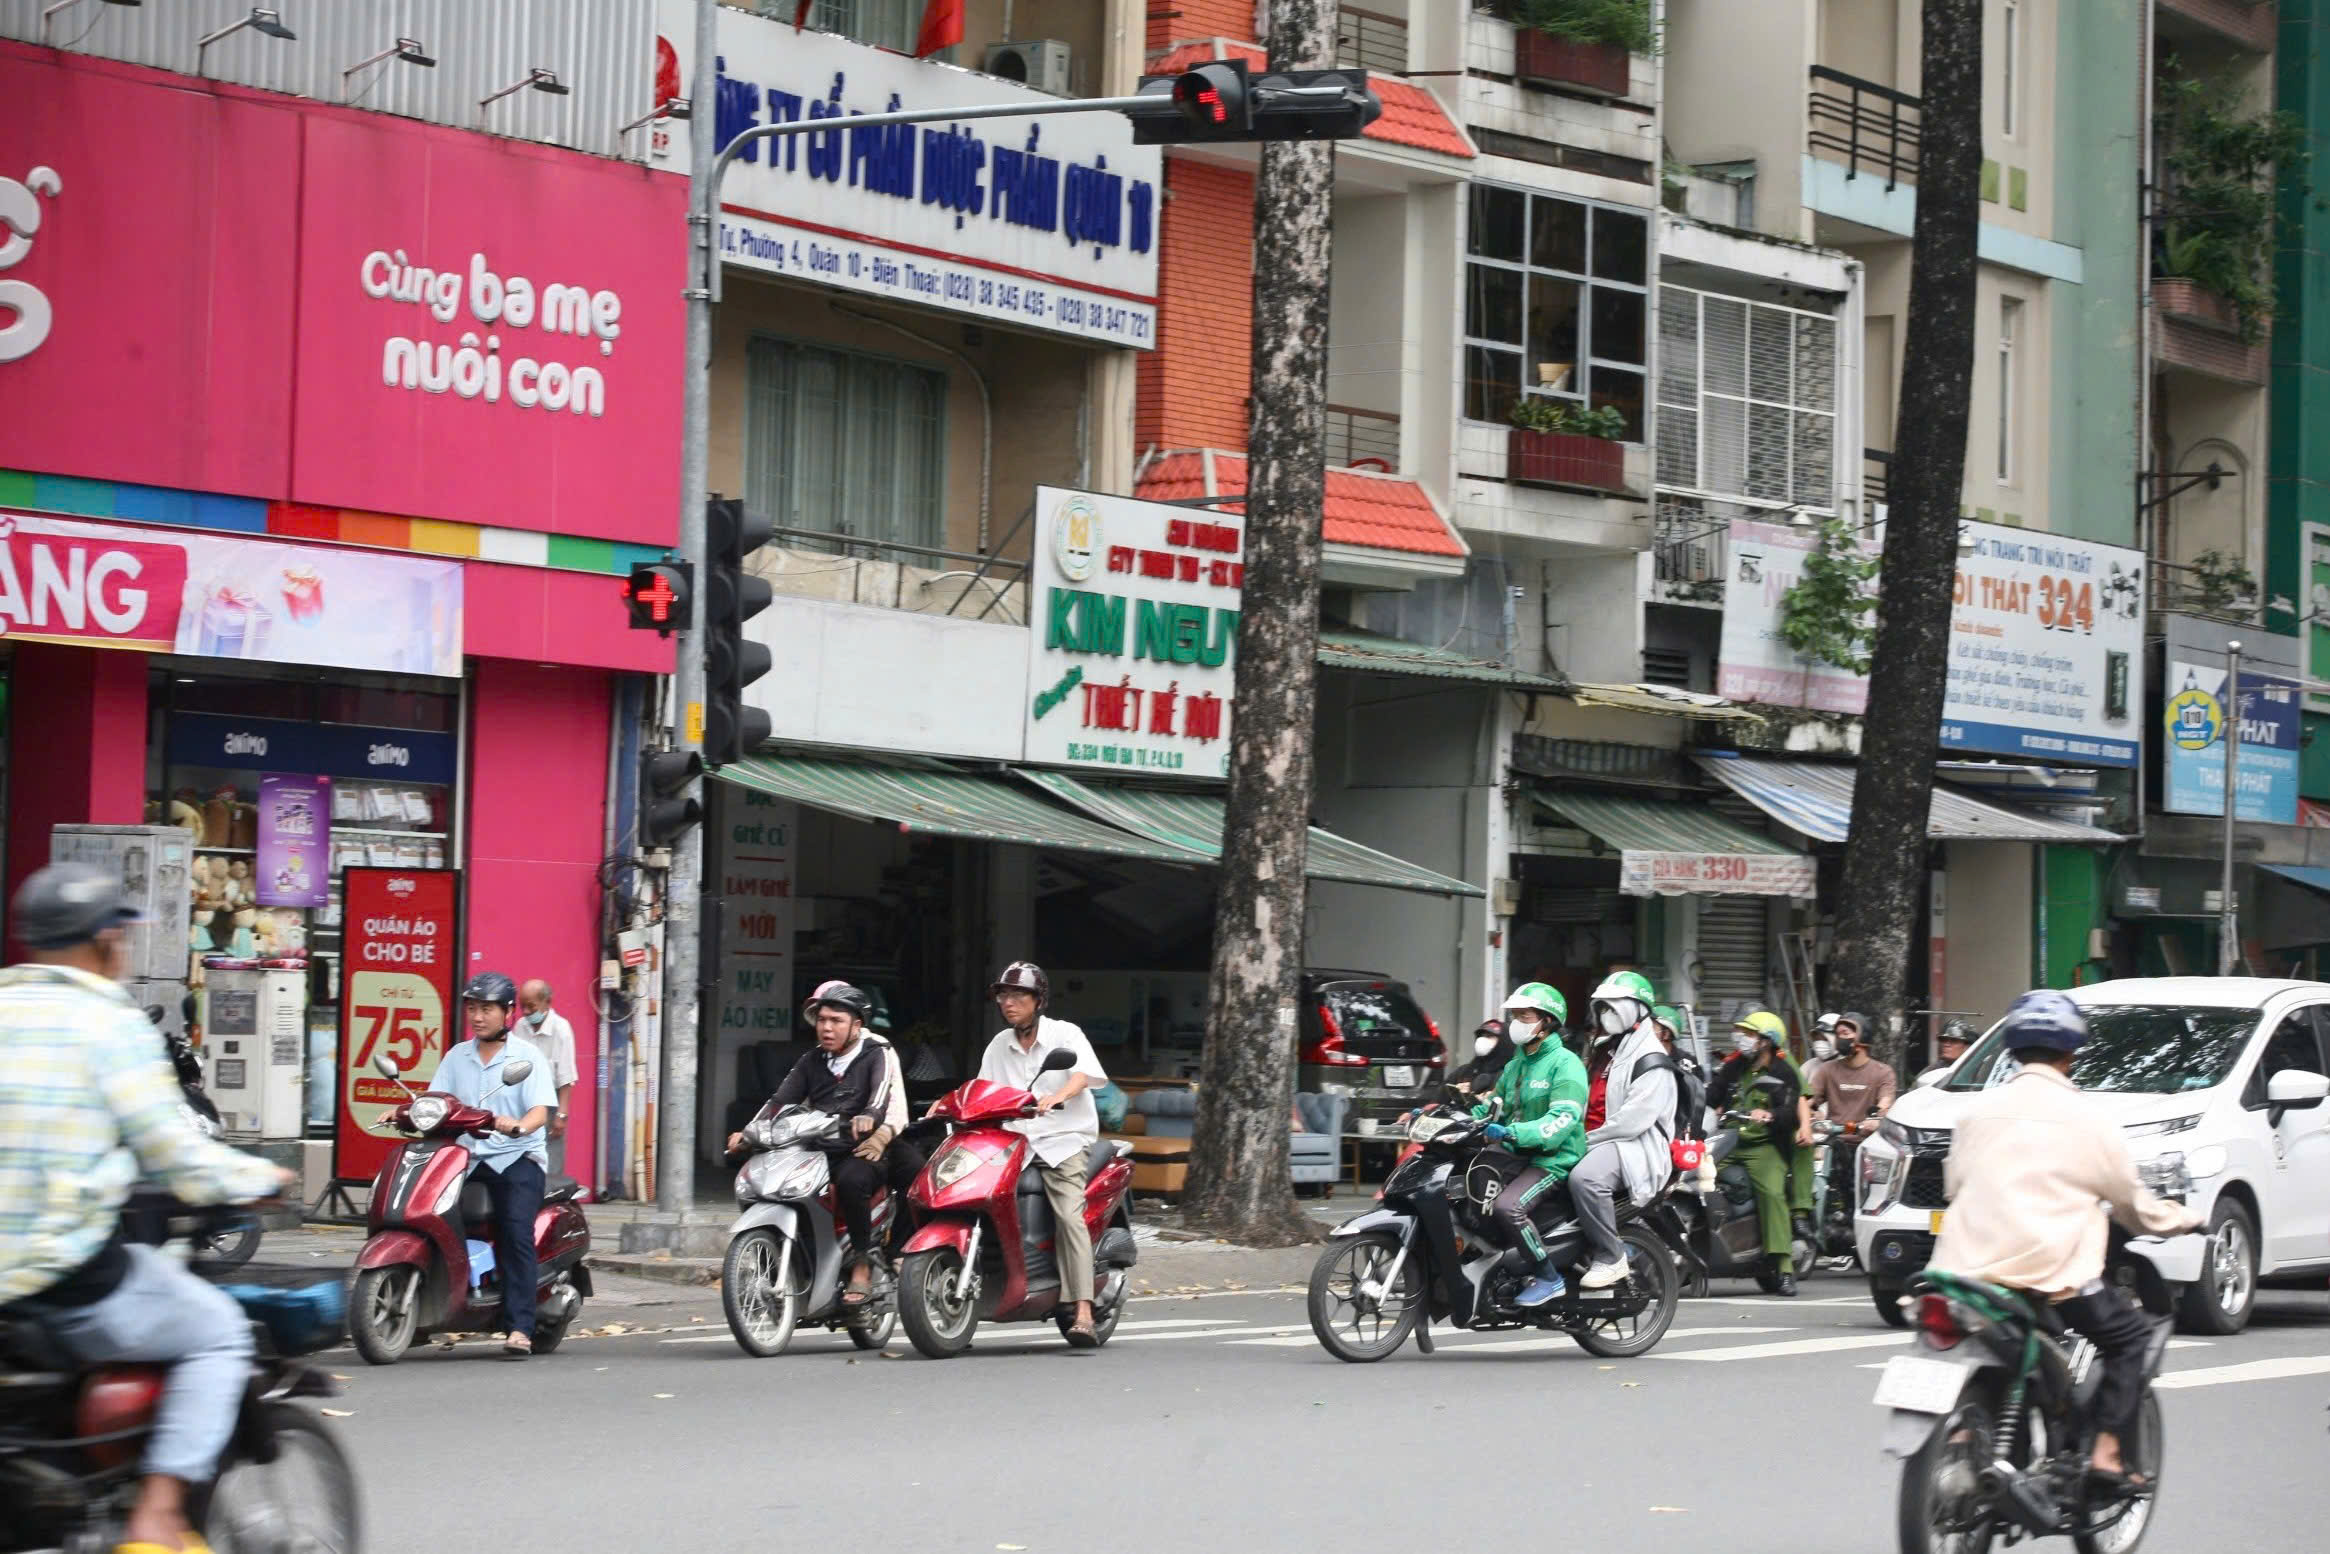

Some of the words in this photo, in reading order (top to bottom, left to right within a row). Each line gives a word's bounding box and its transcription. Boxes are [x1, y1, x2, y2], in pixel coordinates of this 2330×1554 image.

[1064, 155, 1123, 261] QUẬN
[1128, 180, 1152, 254] 10
[361, 249, 461, 323] Cùng
[470, 253, 535, 327] ba
[541, 282, 622, 356] mẹ
[740, 228, 785, 271] Phường
[808, 242, 840, 279] Quận
[847, 251, 861, 279] 10
[979, 279, 993, 306] 38
[998, 283, 1020, 312] 345
[1023, 291, 1046, 317] 435
[1089, 303, 1103, 329] 38
[1106, 306, 1128, 335] 347
[1131, 312, 1150, 339] 721
[383, 332, 500, 403] nuôi
[509, 357, 605, 417] con
[1046, 585, 1127, 659] KIM
[1980, 571, 2031, 615] THẤT
[2037, 574, 2093, 636] 324
[1703, 856, 1748, 881] 330
[412, 915, 437, 937] ÁO
[363, 942, 407, 962] CHO
[410, 939, 436, 964] BÉ
[736, 970, 775, 992] MAY
[721, 1001, 746, 1028] ÁO
[751, 1006, 791, 1032] NỆM
[1529, 1079, 1550, 1089] Grab
